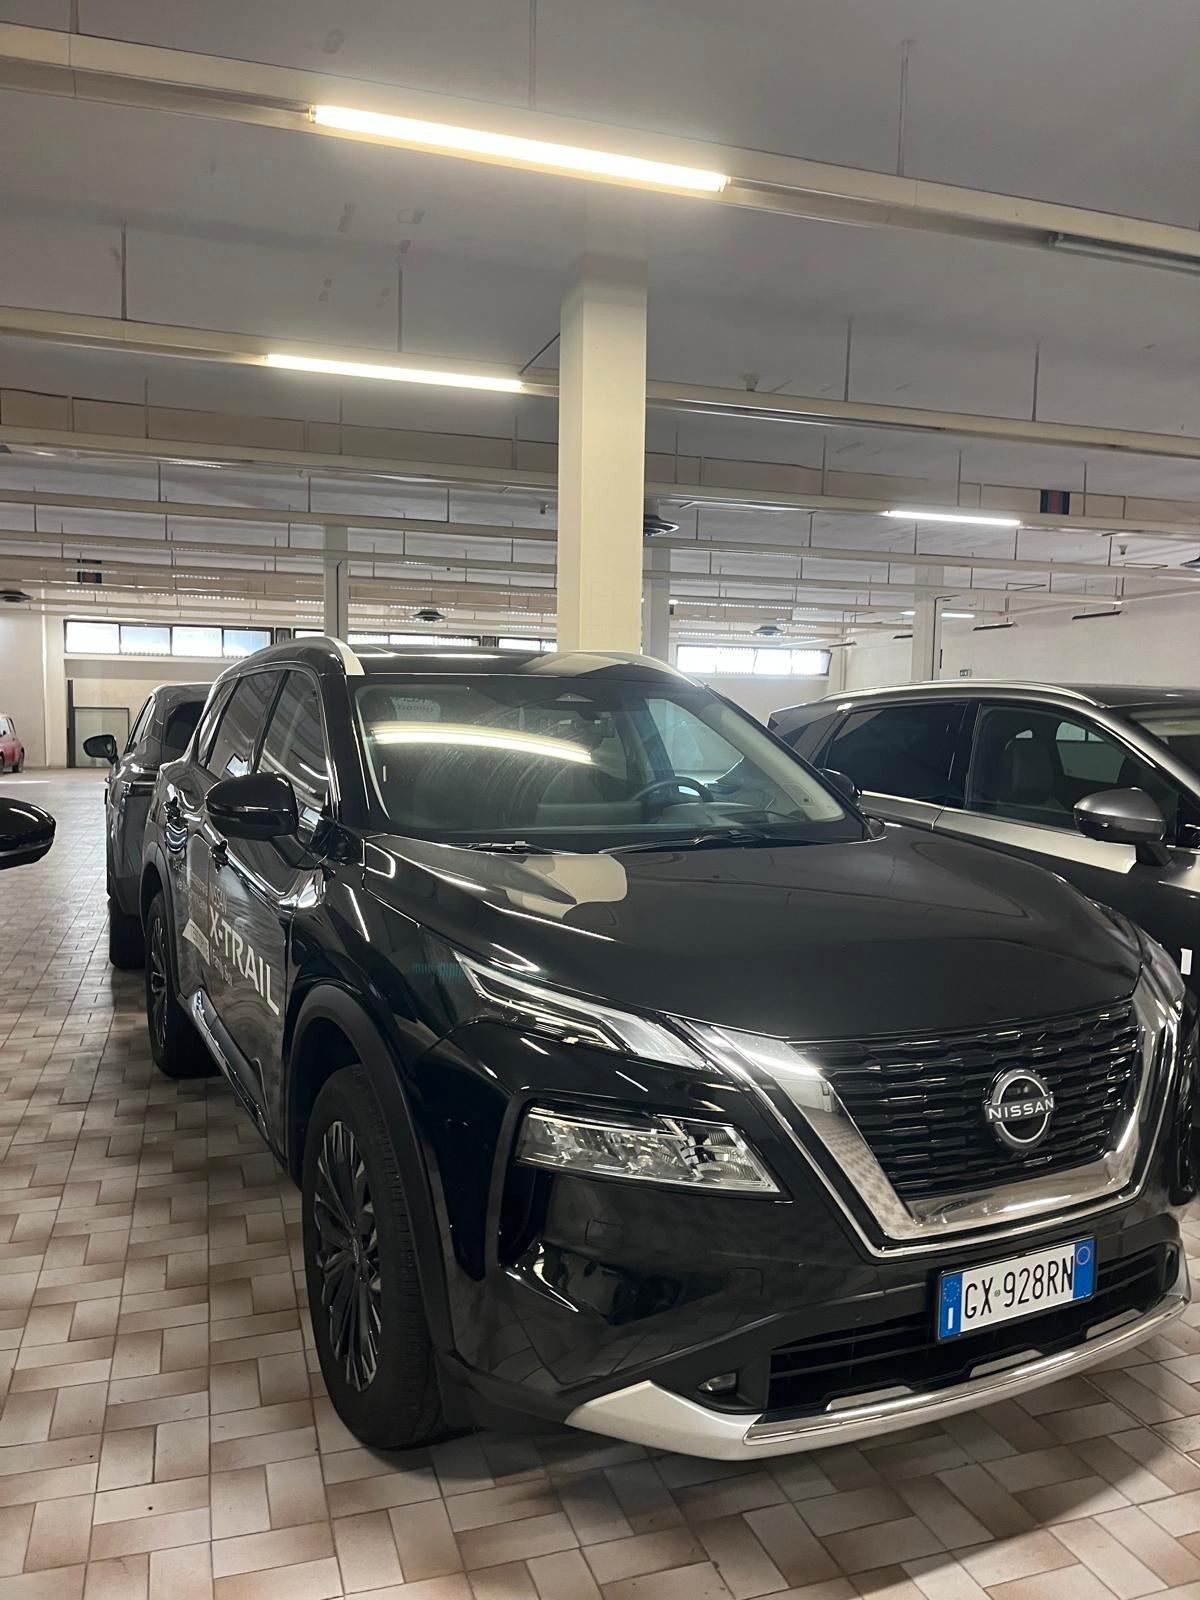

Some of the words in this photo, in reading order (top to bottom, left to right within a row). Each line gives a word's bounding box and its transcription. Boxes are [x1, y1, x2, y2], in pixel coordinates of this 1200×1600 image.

[209, 904, 280, 1016] X-TRAIL
[987, 1097, 1055, 1120] NISSAN
[948, 1307, 954, 1330] I
[964, 1276, 994, 1319] GX
[1003, 1255, 1075, 1308] 928RN
